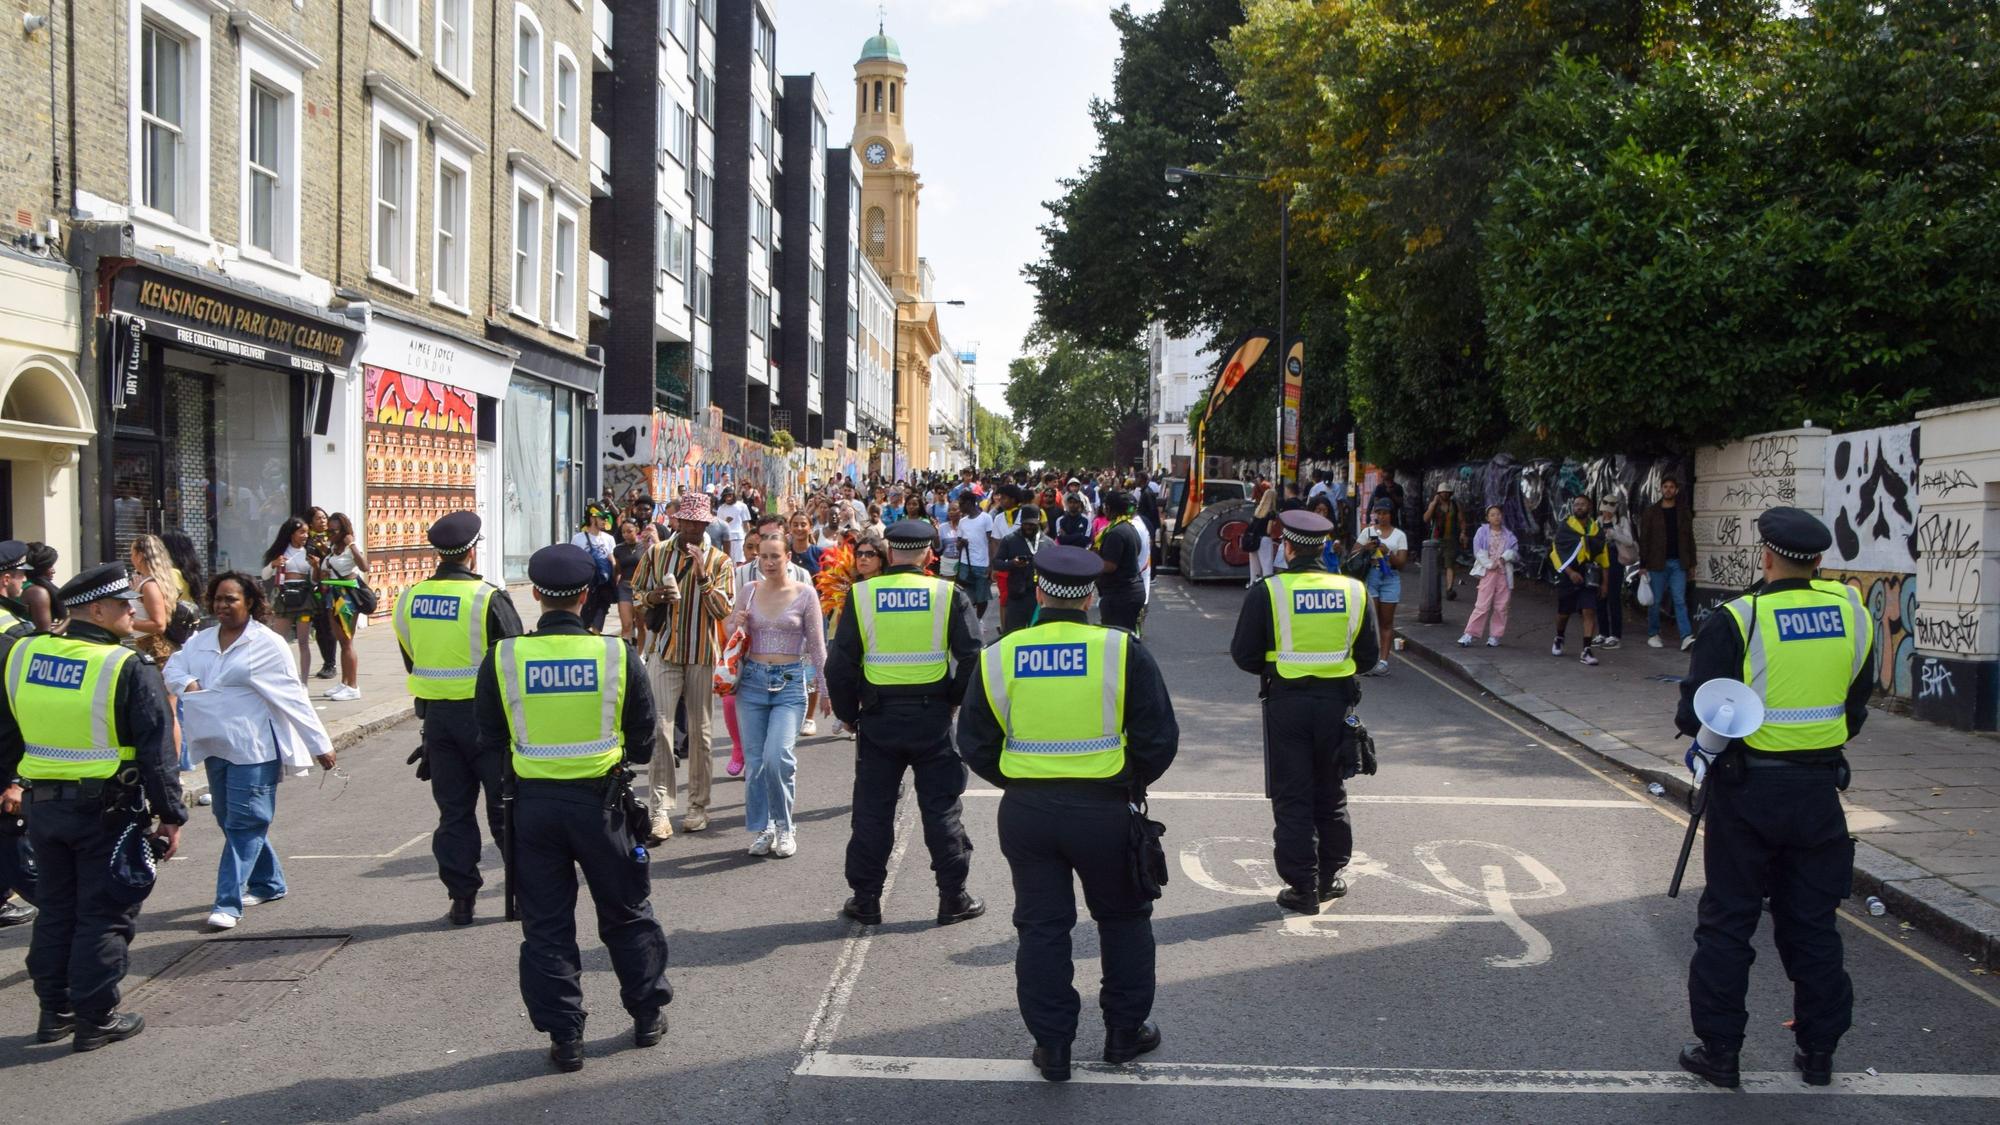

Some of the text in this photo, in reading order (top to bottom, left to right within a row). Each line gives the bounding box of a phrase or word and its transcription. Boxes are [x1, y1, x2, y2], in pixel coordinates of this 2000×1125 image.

[140, 280, 345, 357] KENSINGTON PARK DRY CLEANER
[177, 329, 266, 361] FREE COLLECTION AND DELIVERY
[409, 339, 455, 362] AIMEE JOYCE
[408, 354, 453, 375] LONDON
[126, 372, 139, 395] DRY
[412, 598, 458, 617] POLICE
[878, 590, 928, 608] POLICE
[1295, 592, 1344, 610] POLICE
[1778, 611, 1843, 635] POLICE
[29, 658, 84, 685] POLICE
[1017, 648, 1084, 672] POLICE
[528, 664, 595, 688] POLICE
